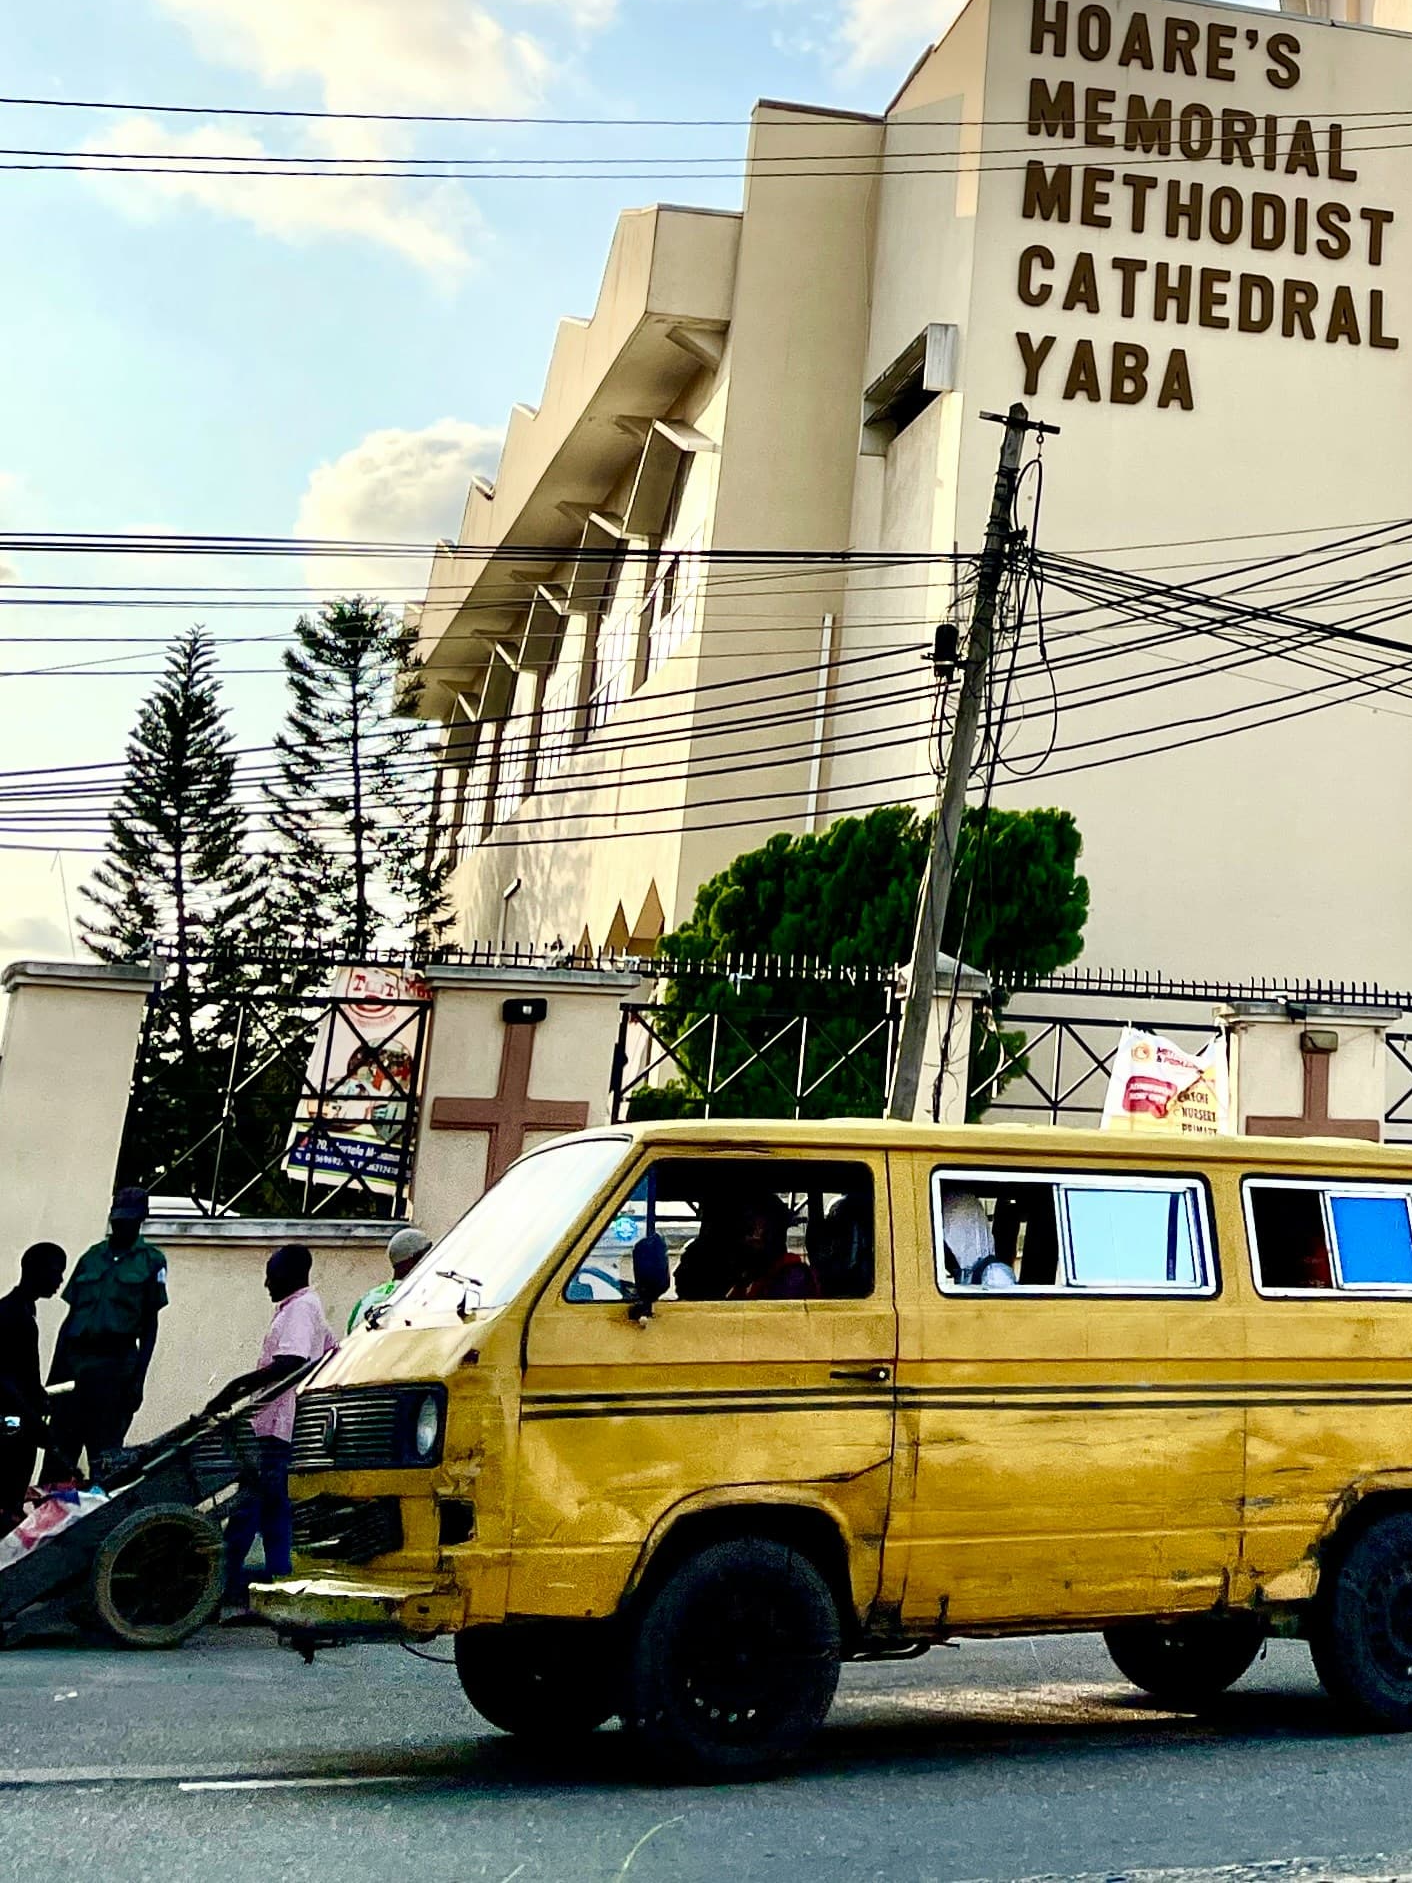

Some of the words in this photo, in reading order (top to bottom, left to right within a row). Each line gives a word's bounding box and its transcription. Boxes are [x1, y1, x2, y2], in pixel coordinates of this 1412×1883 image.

[1027, 78, 1358, 182] MEMORIAL
[1022, 159, 1394, 266] METHODIST
[1016, 244, 1399, 350] CATHEDRAL
[1015, 330, 1194, 411] YABA
